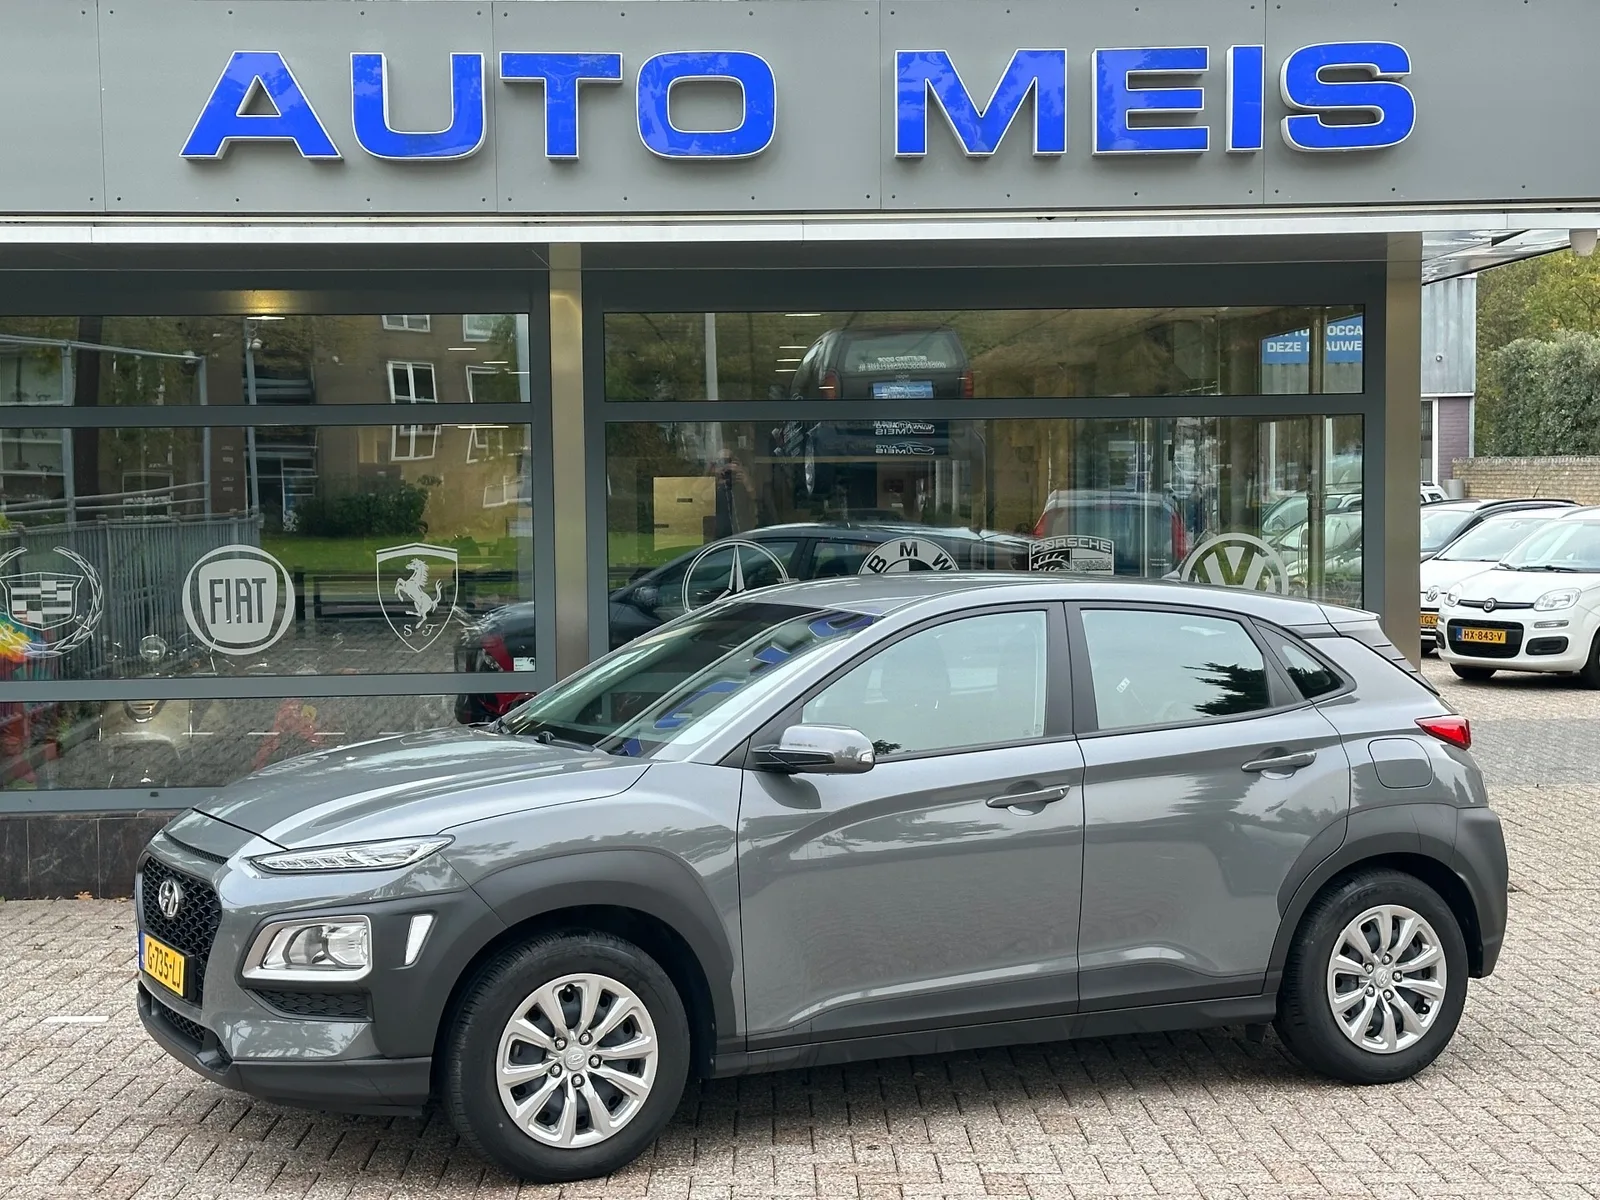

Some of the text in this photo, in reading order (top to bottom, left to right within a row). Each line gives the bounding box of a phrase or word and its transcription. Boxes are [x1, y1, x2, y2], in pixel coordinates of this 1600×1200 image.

[180, 41, 1417, 161] AUTO MEIS
[1267, 342, 1301, 352] DEZE
[867, 541, 953, 573] BMW
[1032, 537, 1111, 554] PORSCHE
[209, 578, 267, 624] FIAT
